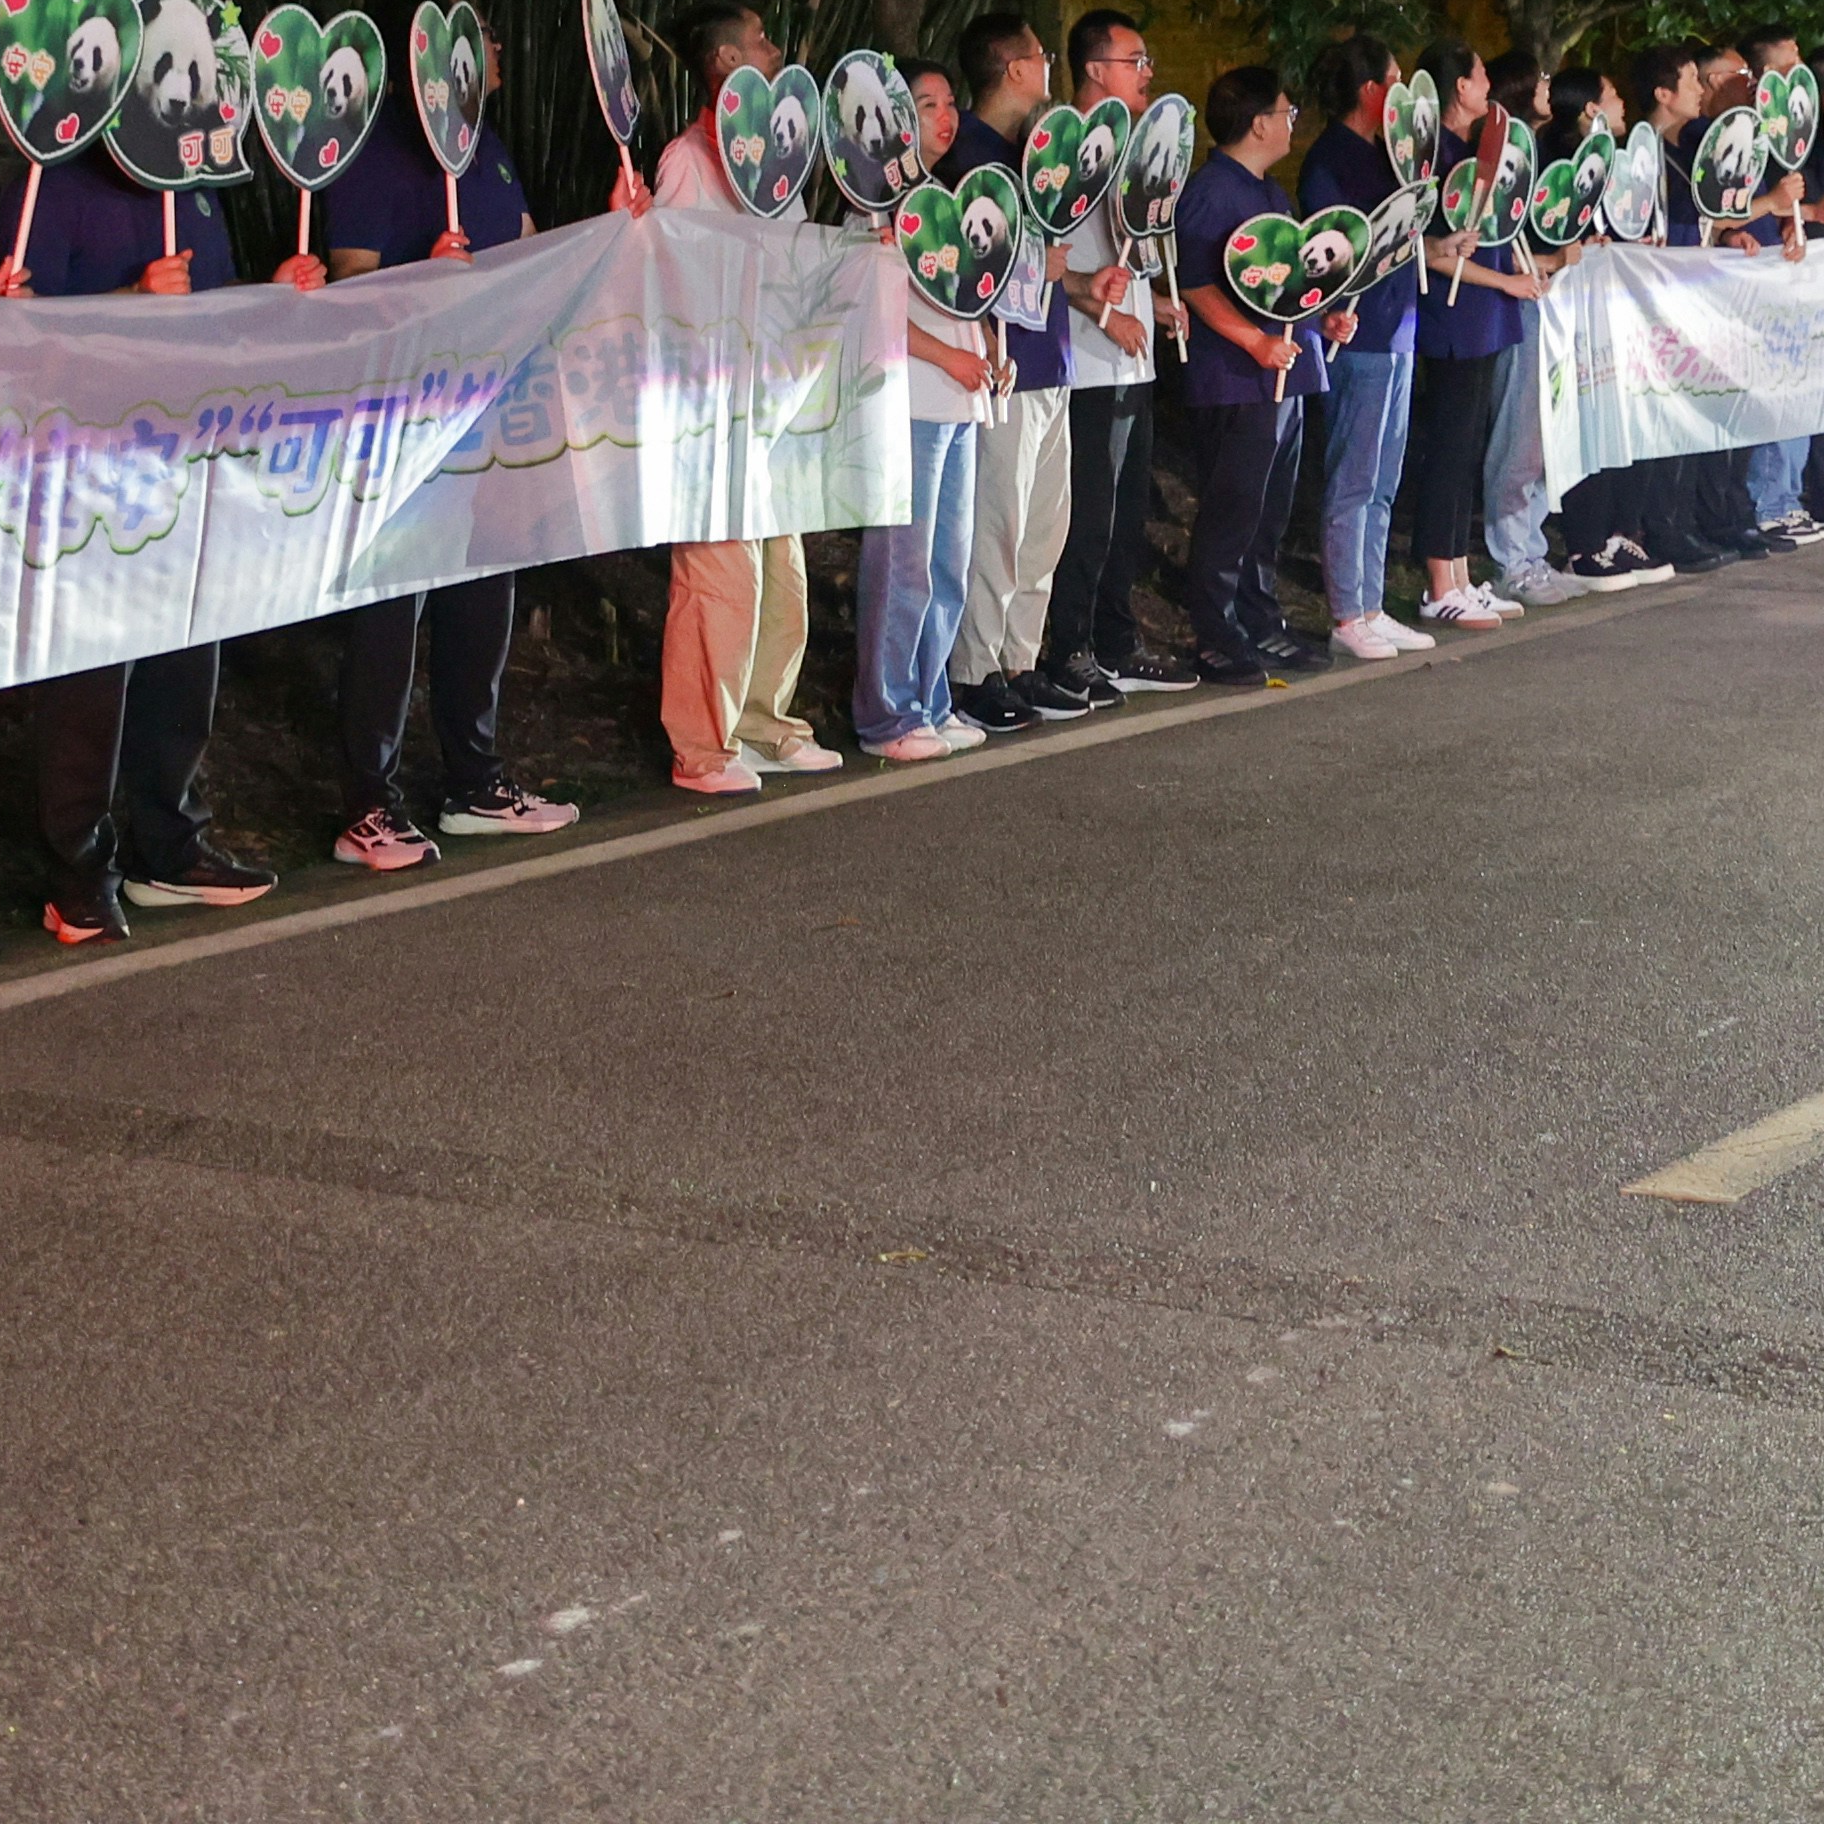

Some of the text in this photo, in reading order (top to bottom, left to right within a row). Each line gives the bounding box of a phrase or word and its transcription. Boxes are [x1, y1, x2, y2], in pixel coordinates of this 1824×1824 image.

[4, 46, 54, 85] 安安
[267, 86, 310, 119] 安安
[180, 128, 234, 166] 可可
